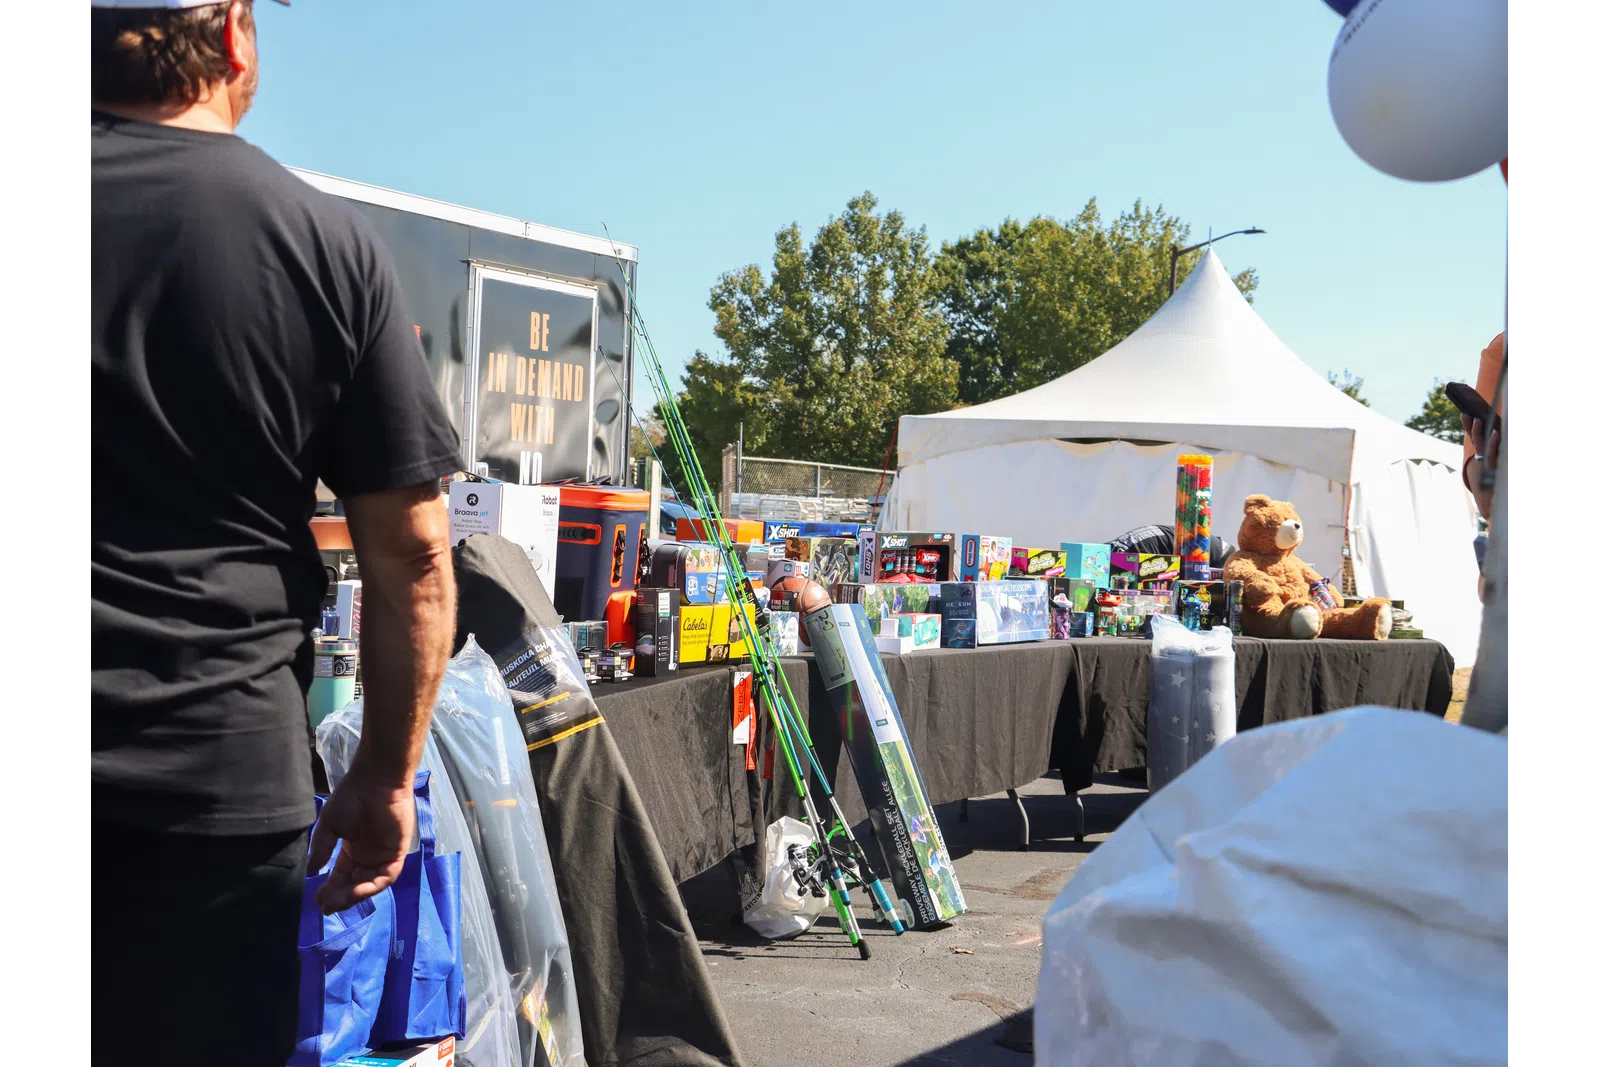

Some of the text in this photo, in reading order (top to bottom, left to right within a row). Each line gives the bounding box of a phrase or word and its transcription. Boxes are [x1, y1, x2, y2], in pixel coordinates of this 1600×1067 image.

[529, 311, 550, 352] BE
[487, 352, 584, 402] IN DEMAND
[510, 403, 555, 445] WITH
[454, 508, 489, 518] Braava jet
[683, 617, 708, 631] Cabela's
[883, 808, 893, 825] SET
[892, 810, 914, 858] PICKLEBALL
[892, 830, 911, 877] PICKLEBALL
[911, 860, 919, 872] DE
[909, 879, 929, 924] DRIVEWAY
[914, 873, 936, 921] ENSEMBLE
